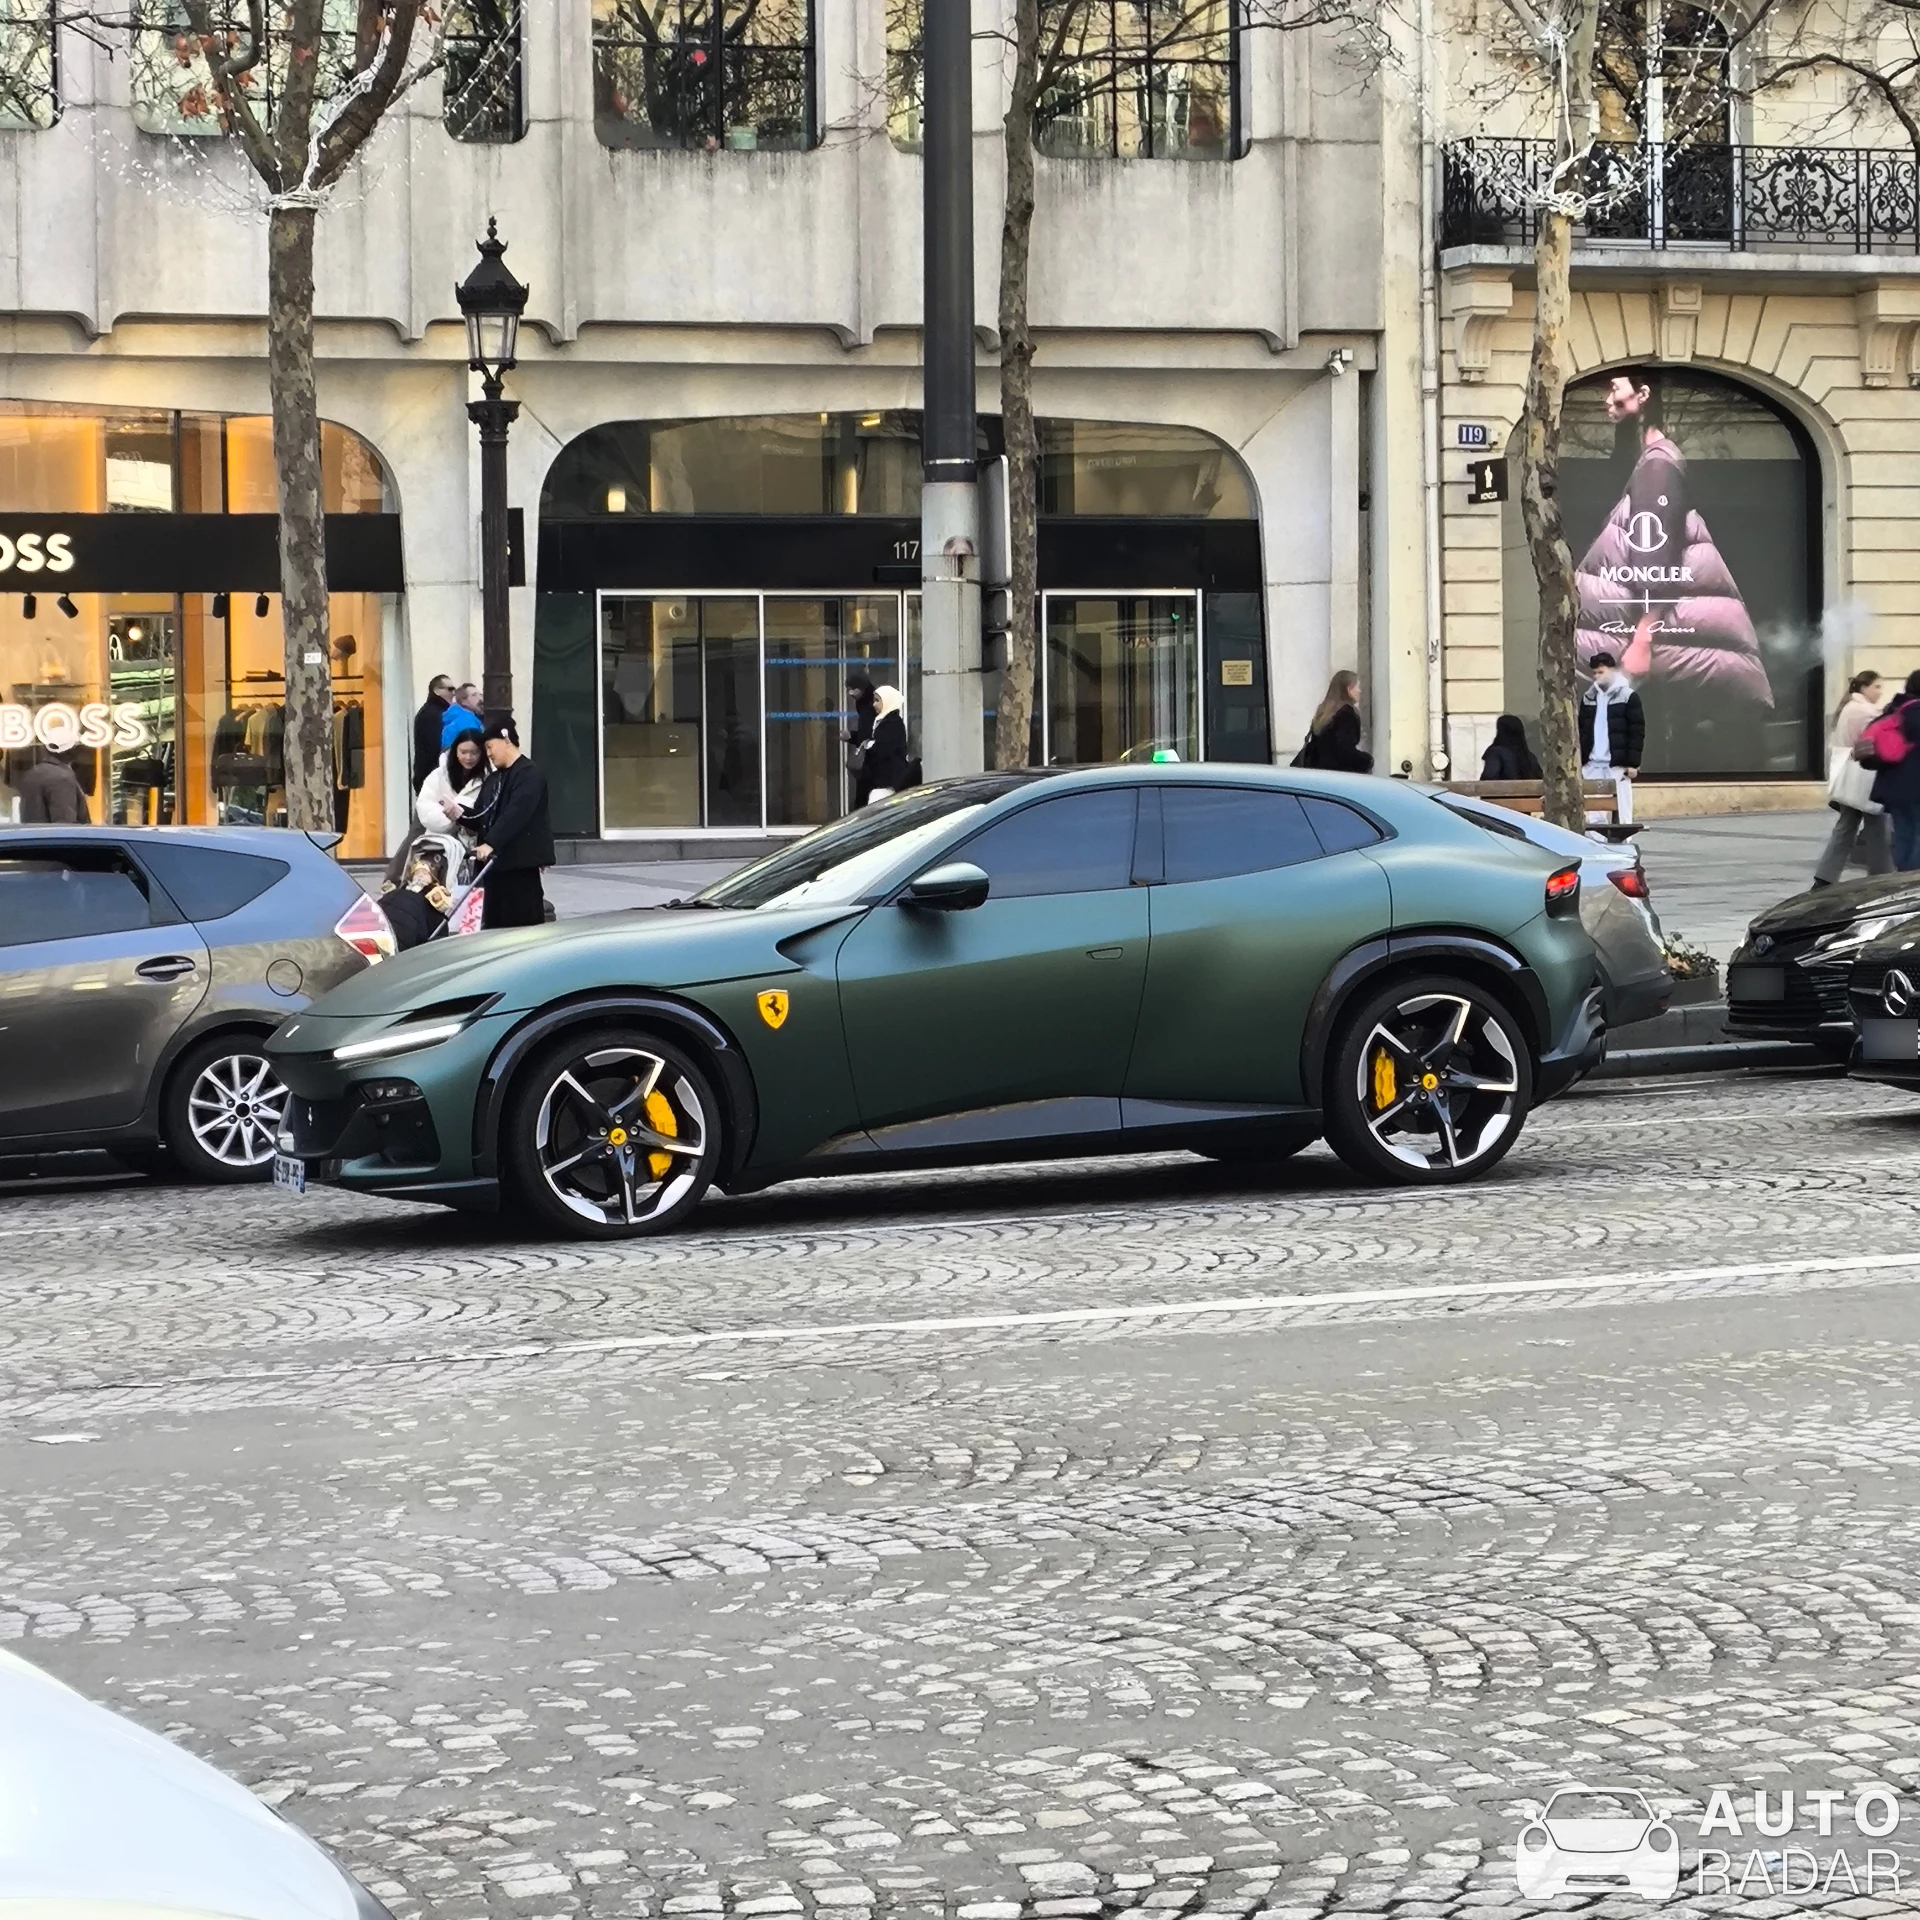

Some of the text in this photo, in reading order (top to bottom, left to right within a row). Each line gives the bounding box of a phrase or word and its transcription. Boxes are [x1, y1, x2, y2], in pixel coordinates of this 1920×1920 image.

[1461, 427, 1484, 443] 119
[893, 541, 920, 559] 117
[1600, 566, 1694, 582] MONCLER
[0, 702, 147, 748] BOSS
